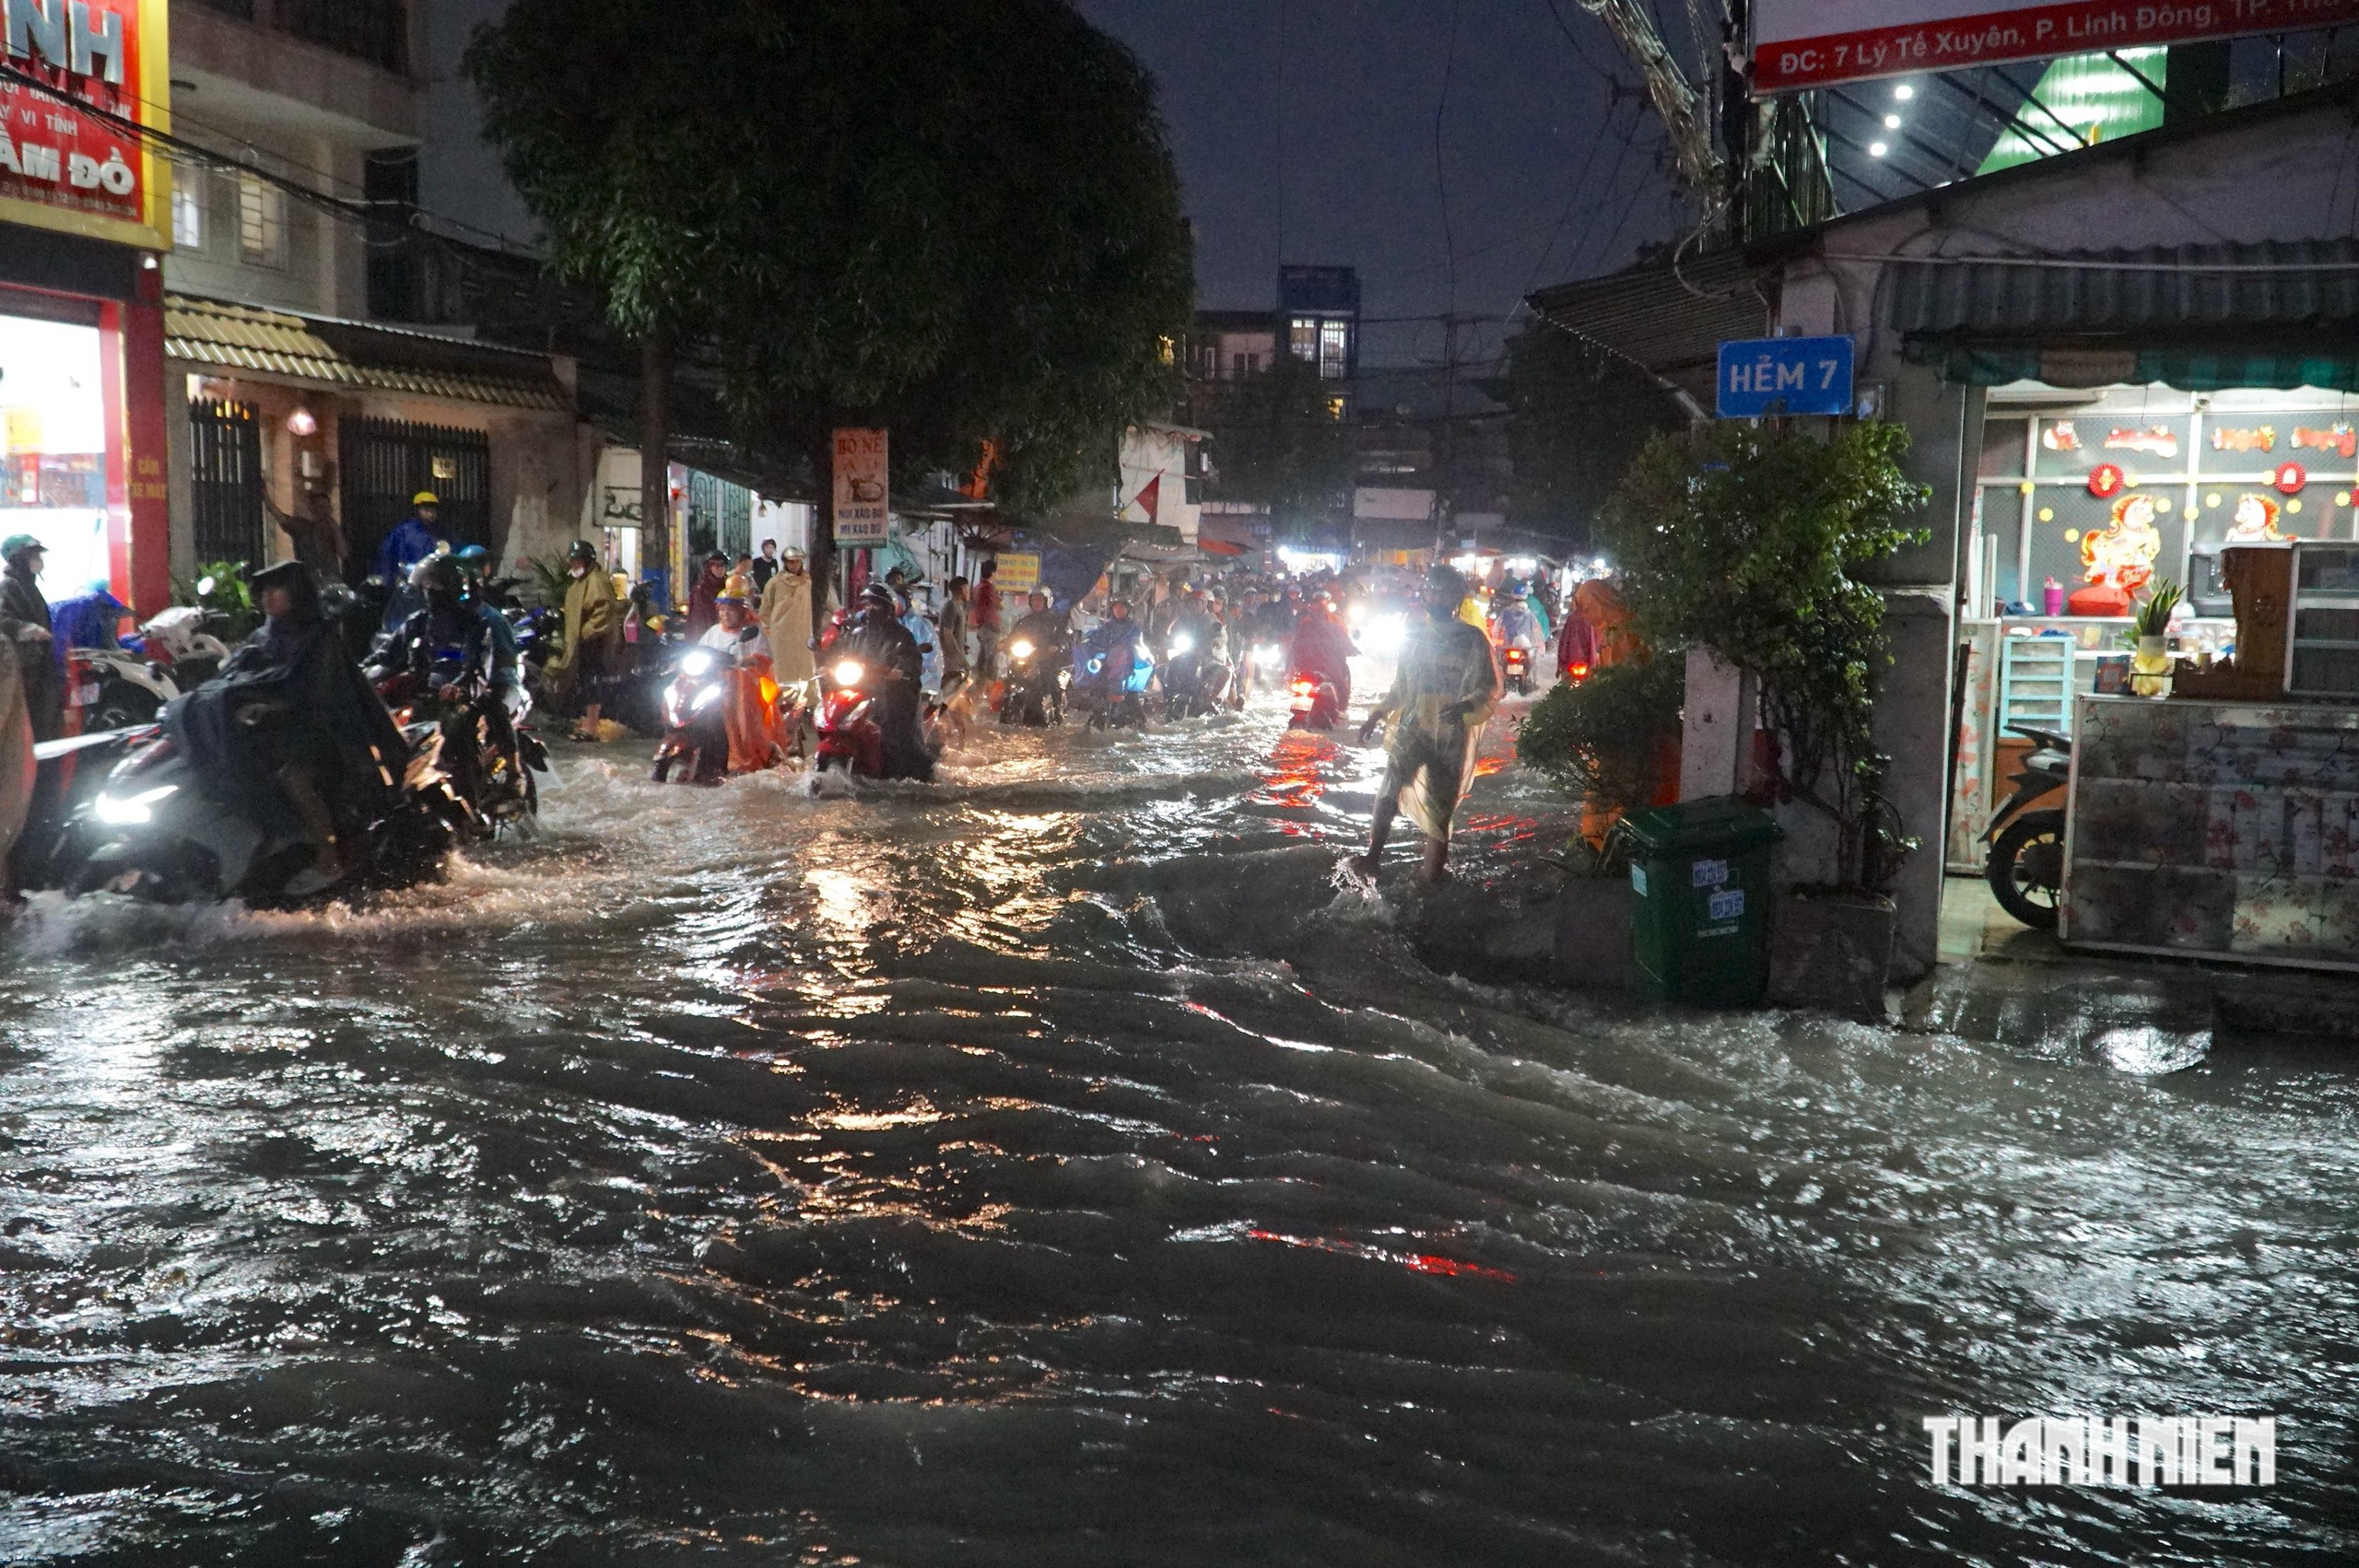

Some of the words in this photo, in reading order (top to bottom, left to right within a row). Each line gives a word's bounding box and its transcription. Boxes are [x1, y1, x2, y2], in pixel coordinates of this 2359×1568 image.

[1835, 46, 1848, 67] 7
[2067, 16, 2128, 38] Linh
[1819, 359, 1838, 391] 7
